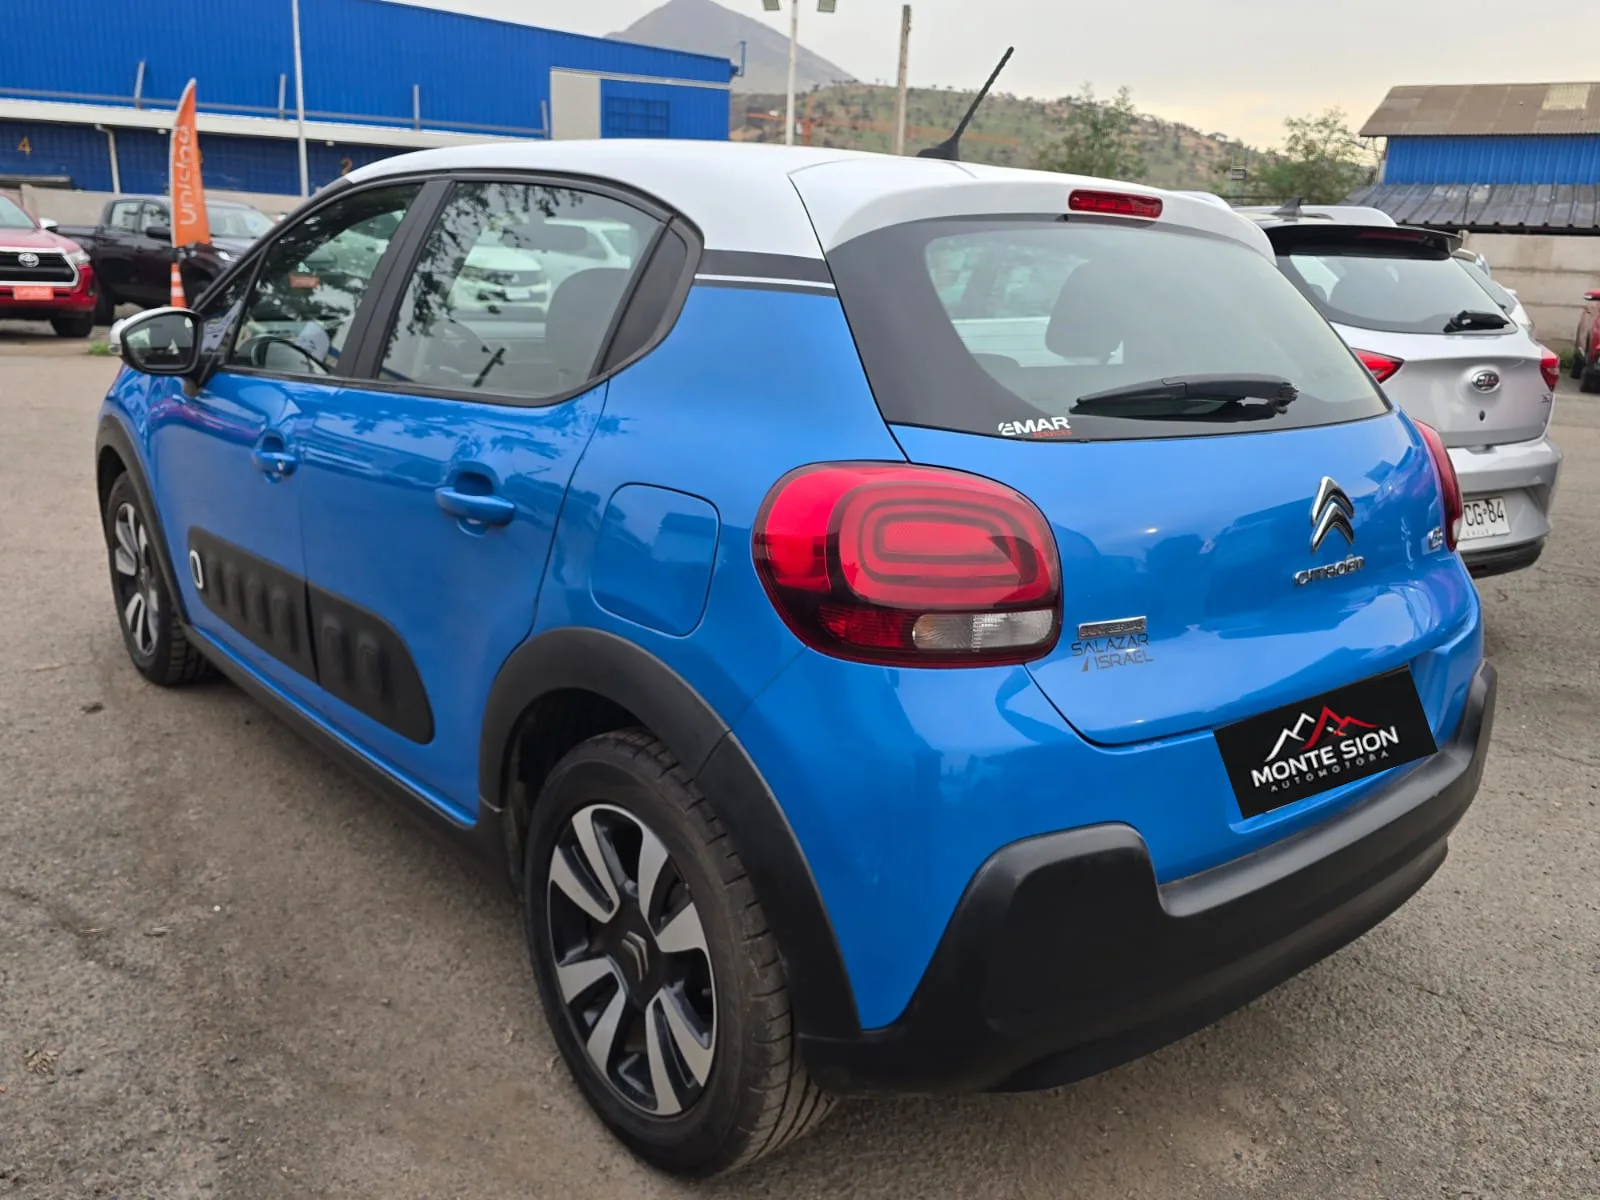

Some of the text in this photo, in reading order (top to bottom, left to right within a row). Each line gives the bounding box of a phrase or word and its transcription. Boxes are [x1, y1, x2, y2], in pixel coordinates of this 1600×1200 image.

[16, 136, 33, 156] 4
[1070, 633, 1150, 657] SALAZAR
[1094, 648, 1154, 670] ISRAEL
